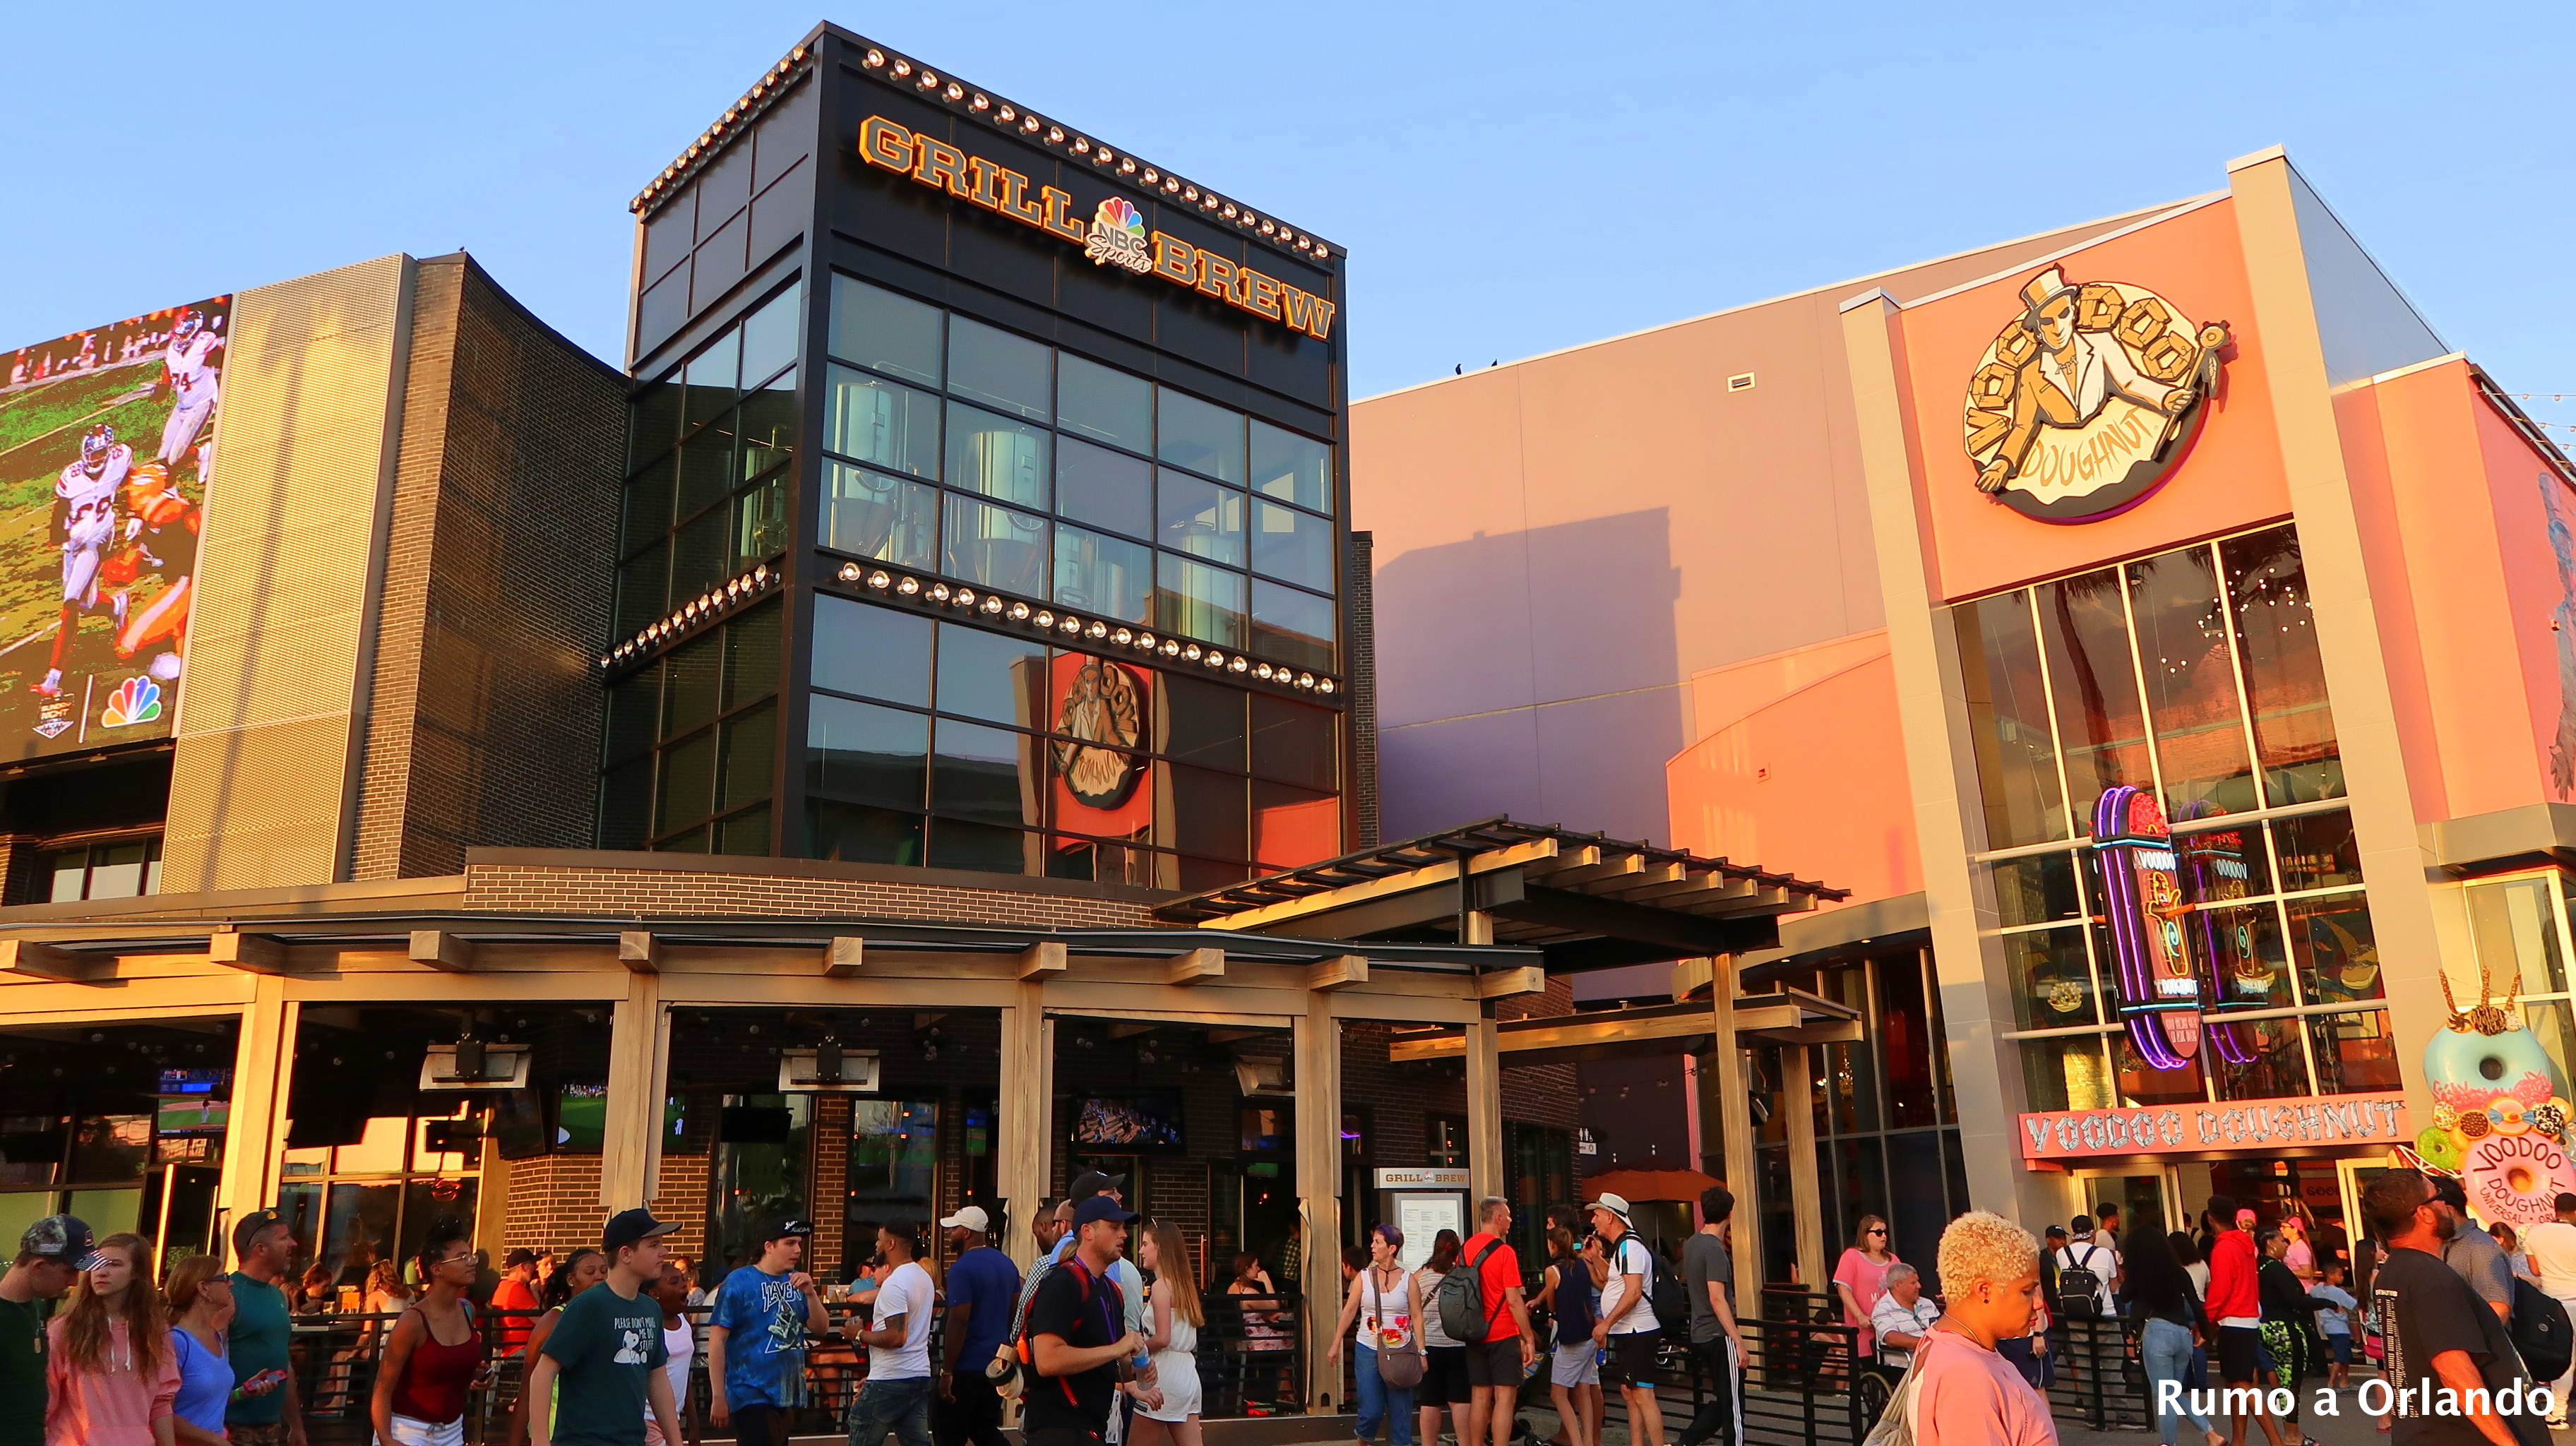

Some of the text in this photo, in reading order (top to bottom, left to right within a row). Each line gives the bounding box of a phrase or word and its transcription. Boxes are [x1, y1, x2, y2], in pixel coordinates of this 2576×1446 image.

[859, 114, 1335, 340] GRILL BREW
[1098, 222, 1145, 256] NBC
[1090, 234, 1150, 270] Sports
[1966, 285, 2197, 457] VOODOO
[2020, 406, 2154, 487] DOUGHNUT
[2137, 849, 2177, 871] VOODOO
[2024, 1099, 2406, 1153] VOODOO DOUGHNUT
[2472, 1137, 2562, 1172] VOODOO
[1385, 1174, 1423, 1183] GRILL
[1435, 1174, 1466, 1183] BREW
[2306, 1186, 2339, 1196] GOO
[2487, 1177, 2566, 1213] DOUGHNUT
[2479, 1187, 2524, 1224] UNIVERSAL
[639, 1340, 655, 1351] STUFF
